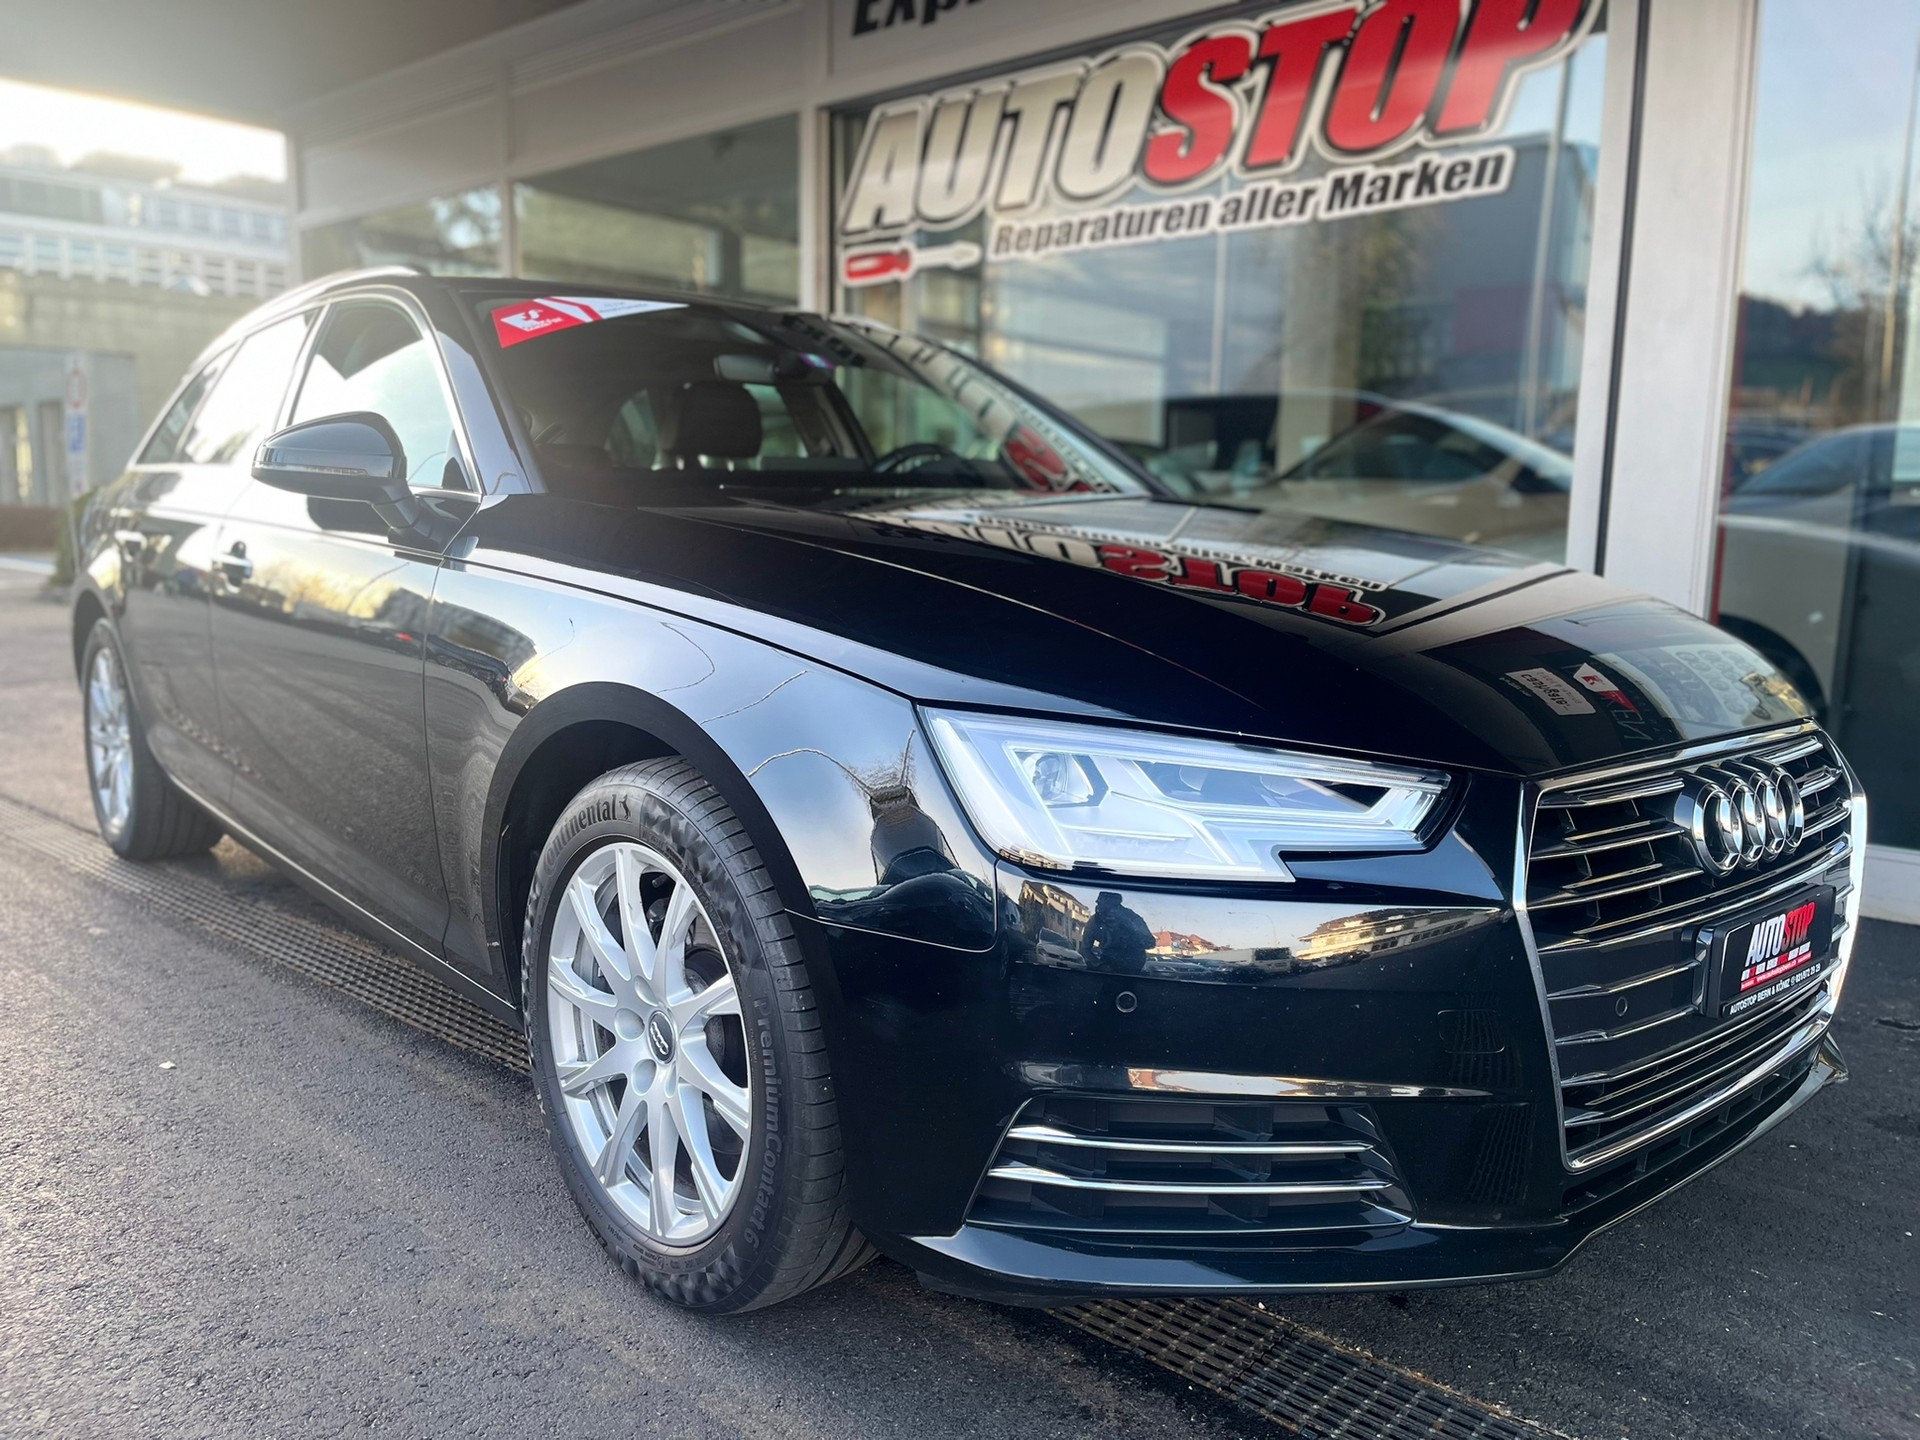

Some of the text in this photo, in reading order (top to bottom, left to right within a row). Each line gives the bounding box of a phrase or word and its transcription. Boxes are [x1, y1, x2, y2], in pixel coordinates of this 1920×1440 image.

[841, 0, 1592, 236] AUTOSTOP
[993, 152, 1505, 256] Reparaturen aller Marken
[543, 793, 618, 876] Continental
[1744, 902, 1815, 967] AUTOSTOP
[1729, 995, 1757, 1015] AUTOSTOP
[1757, 989, 1772, 1002] BERN
